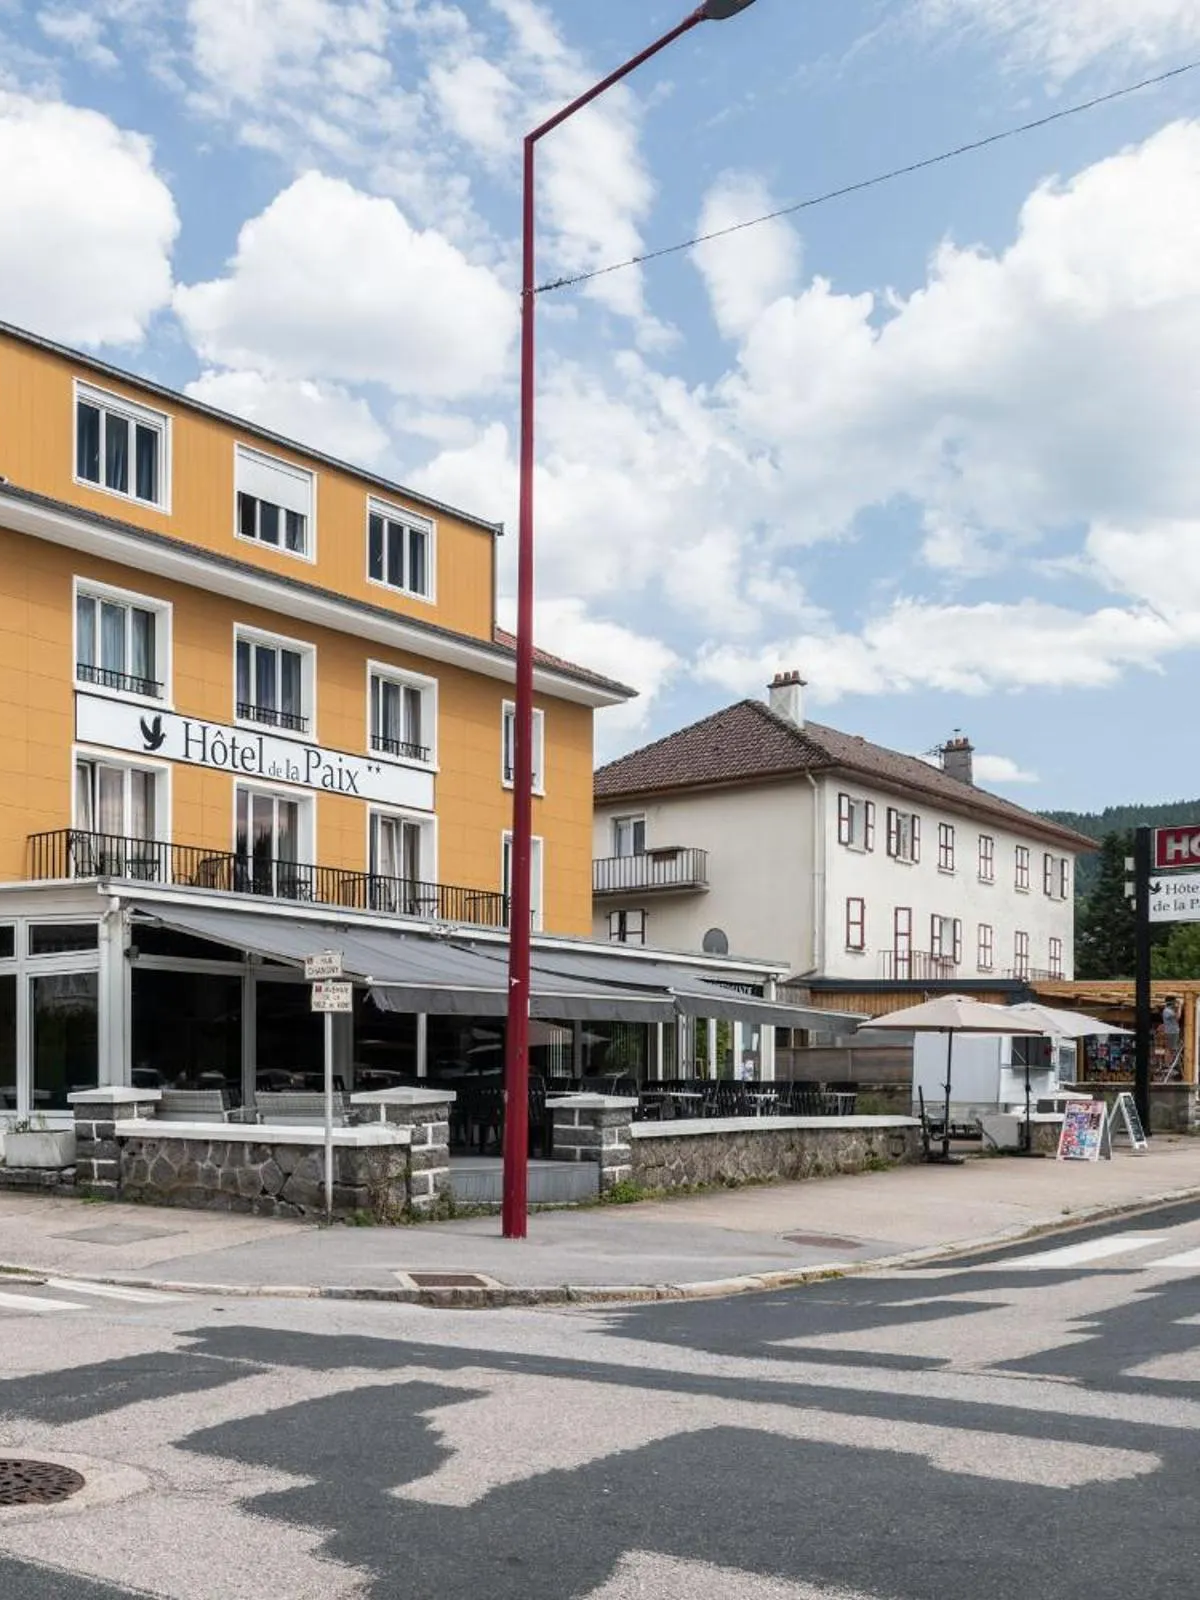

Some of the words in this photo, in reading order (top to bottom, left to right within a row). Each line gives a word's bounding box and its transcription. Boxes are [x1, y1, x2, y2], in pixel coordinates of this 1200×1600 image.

[183, 721, 264, 773] Hôtel
[269, 760, 283, 778] de
[286, 759, 300, 781] la
[303, 748, 360, 794] Paix
